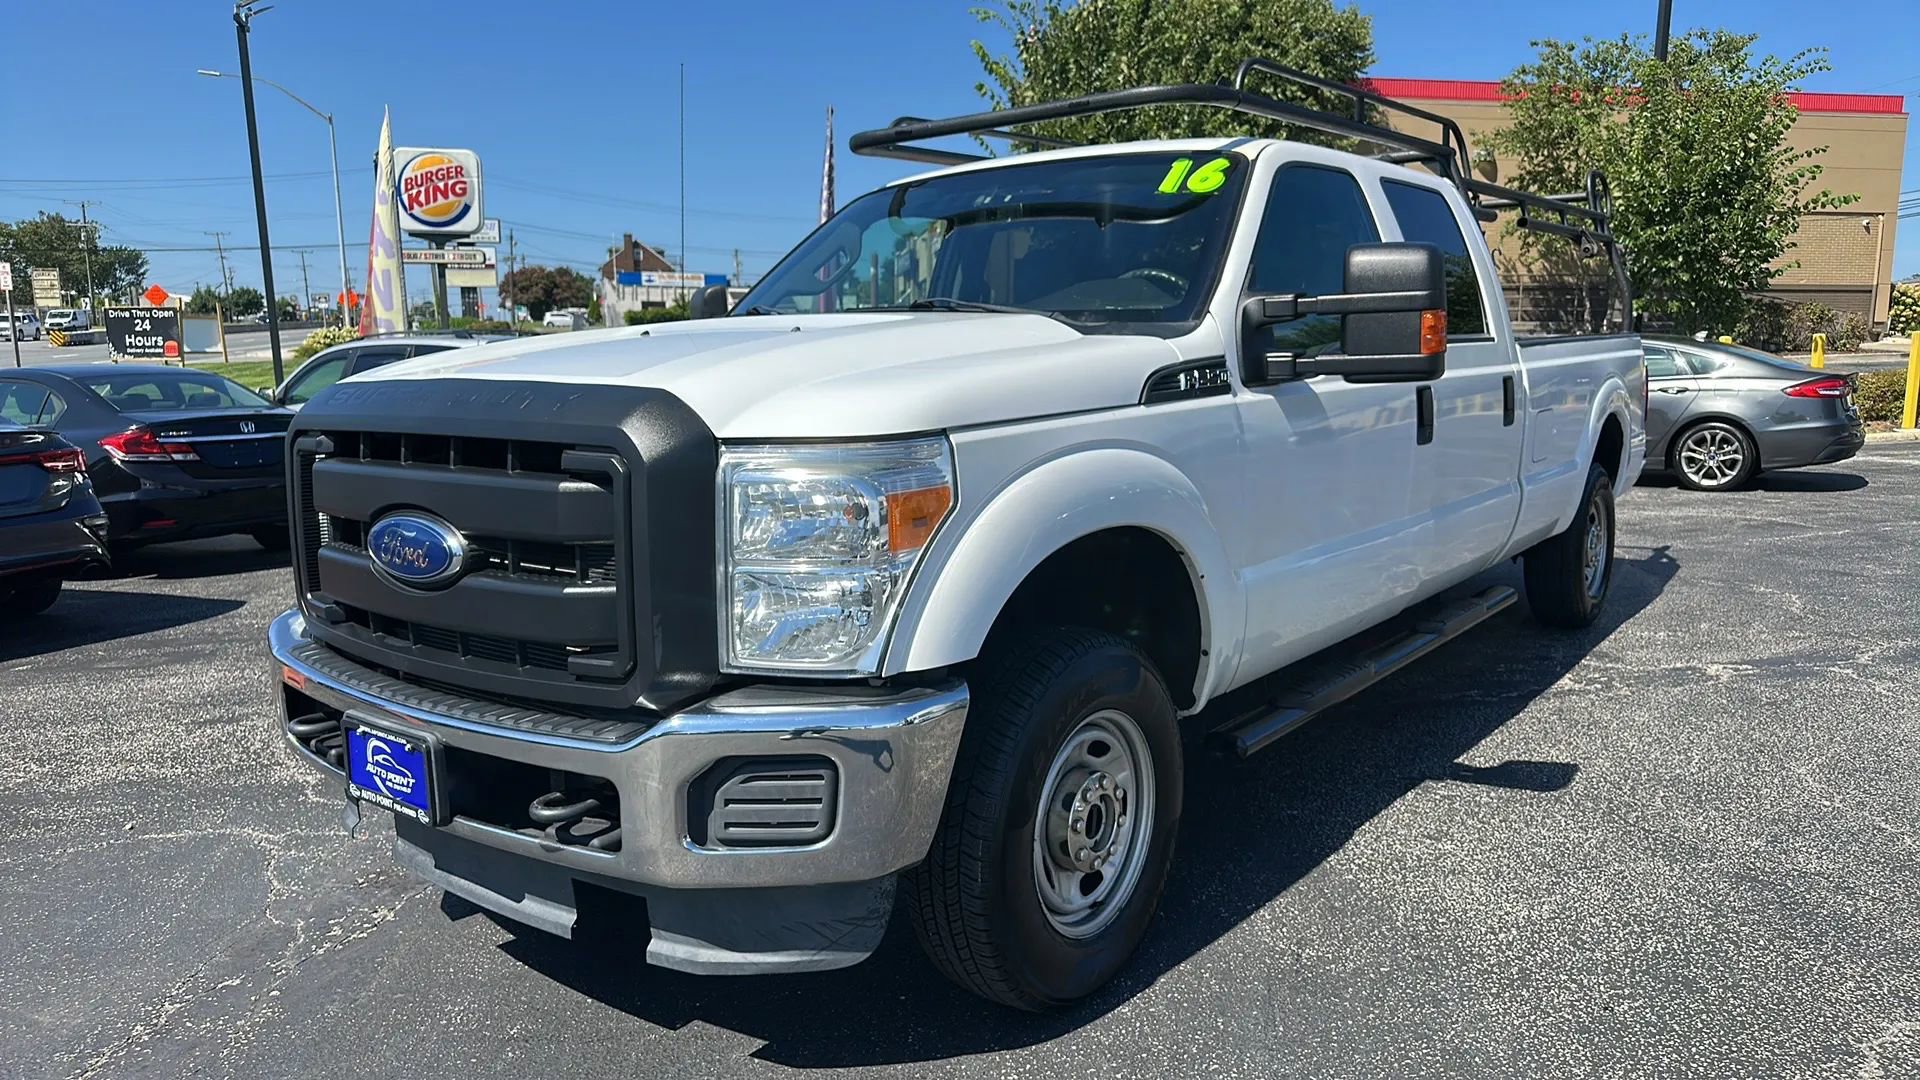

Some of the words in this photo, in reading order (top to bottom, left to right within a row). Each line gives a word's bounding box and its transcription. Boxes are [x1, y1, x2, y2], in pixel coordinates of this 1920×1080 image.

[404, 165, 464, 194] BURGER
[1158, 157, 1231, 194] 16
[406, 180, 468, 213] KING
[108, 309, 130, 318] Drive
[131, 309, 150, 318] Thru
[152, 309, 174, 319] Open
[134, 318, 152, 332] 24
[125, 334, 164, 347] Hours
[381, 527, 430, 569] Ford
[366, 763, 387, 778] AUTO
[387, 773, 416, 788] POINT
[361, 789, 376, 802] AUTO
[376, 794, 394, 808] POINT
